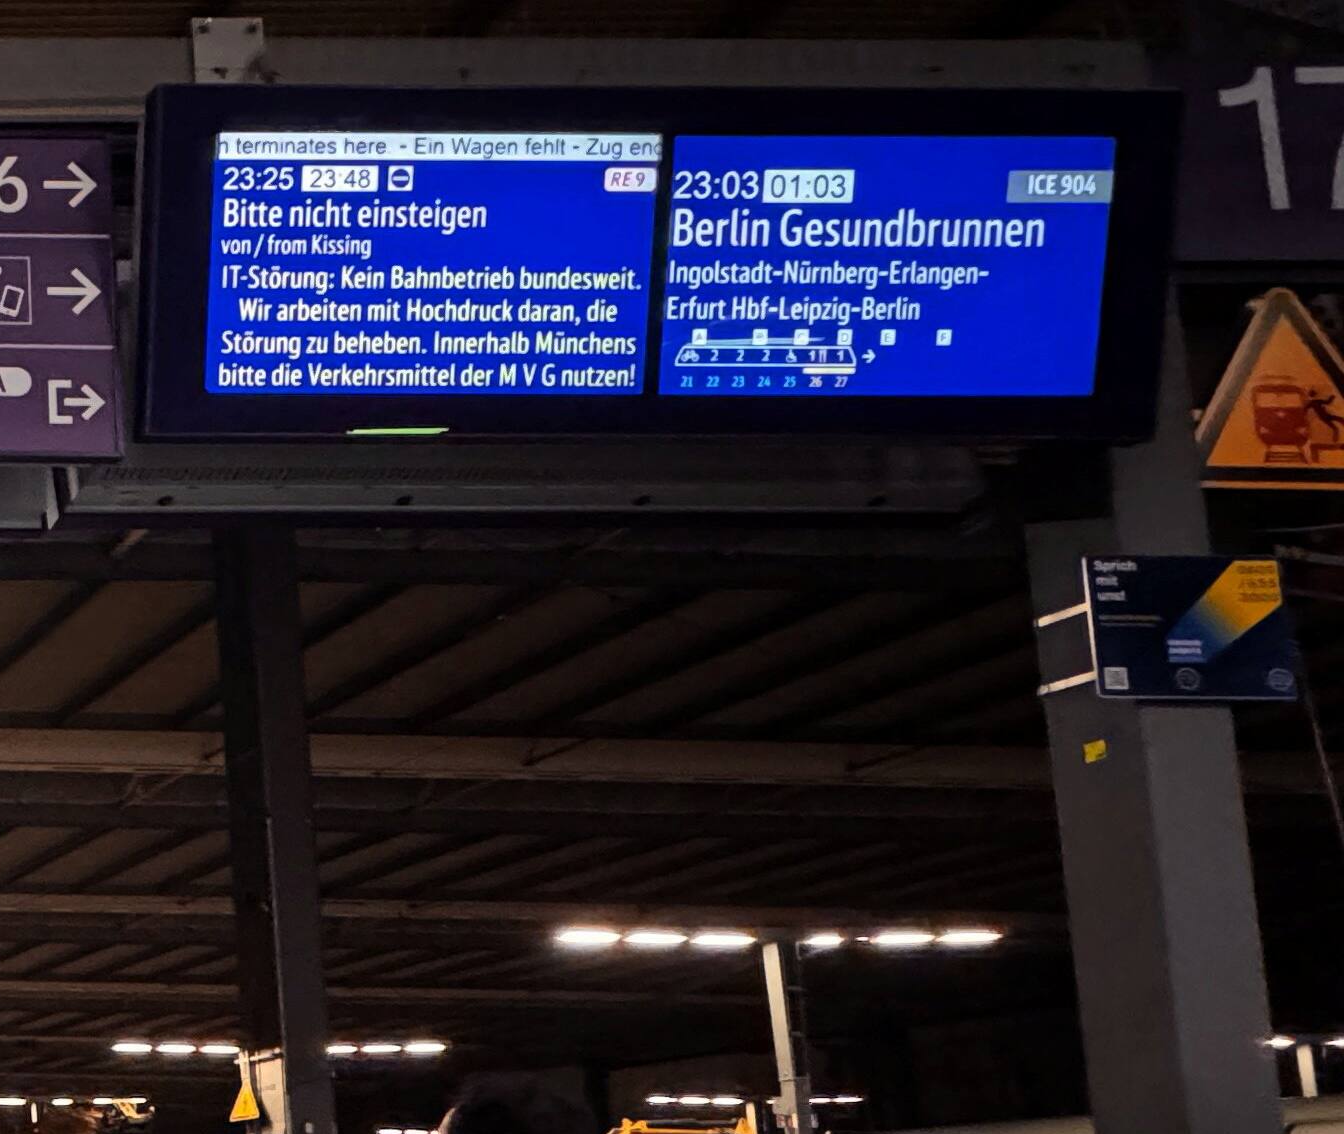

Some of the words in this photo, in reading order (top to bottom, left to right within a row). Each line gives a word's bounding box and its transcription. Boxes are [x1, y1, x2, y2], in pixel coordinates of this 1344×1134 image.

[236, 138, 337, 155] terminates
[414, 137, 444, 155] Ein
[451, 137, 518, 159] Wagen
[525, 138, 565, 156] fehlt
[585, 138, 623, 160] Zug
[222, 167, 295, 191] 23:25
[610, 172, 632, 187] RE
[635, 172, 646, 187] 9
[673, 170, 760, 200] 23:03
[770, 174, 846, 199] 01:03
[1028, 174, 1058, 195] ICE
[1060, 174, 1096, 195] 904
[223, 198, 283, 228] Bitte
[289, 198, 352, 228] nicht
[357, 198, 487, 236] einsteigen
[672, 208, 770, 247] Berlin
[779, 208, 1045, 247] Gesundbrunnen
[221, 240, 252, 256] von
[267, 234, 307, 255] from
[311, 234, 372, 260] Kissing
[222, 265, 335, 295] IT-Störung:
[341, 265, 384, 289] Kein
[390, 265, 514, 290] Bahnbetrieb
[519, 265, 642, 290] bundesweit.
[668, 259, 989, 290] Ingolstadt-Nürnberg-Erlangen-
[239, 298, 272, 322] Wir
[276, 298, 362, 322] arbeiten
[367, 298, 401, 322] mit
[406, 298, 513, 322] Hochdruck
[518, 298, 581, 326] daran,
[587, 298, 618, 322] die
[666, 296, 726, 321] Erfurt
[731, 295, 921, 326] Hbf-Leipzig-Berlin
[221, 330, 301, 360] Störung
[305, 336, 329, 354] zu
[334, 330, 428, 354] beheben.
[433, 331, 530, 355] Innerhalb
[535, 331, 637, 355] Münchens
[710, 350, 719, 362] 2
[736, 350, 745, 362] 2
[762, 350, 771, 362] 2
[836, 350, 845, 362] 1
[218, 362, 266, 387] bitte
[271, 362, 303, 387] die
[308, 362, 455, 387] Verkehrsmittel
[460, 363, 494, 387] der
[499, 363, 516, 387] M
[522, 363, 537, 387] V
[541, 363, 556, 387] G
[561, 363, 636, 388] nutzen!
[680, 376, 693, 388] 21
[706, 376, 720, 388] 22
[731, 376, 745, 388] 23
[758, 376, 771, 388] 24
[783, 376, 797, 388] 25
[809, 376, 823, 388] 26
[834, 376, 849, 388] 27
